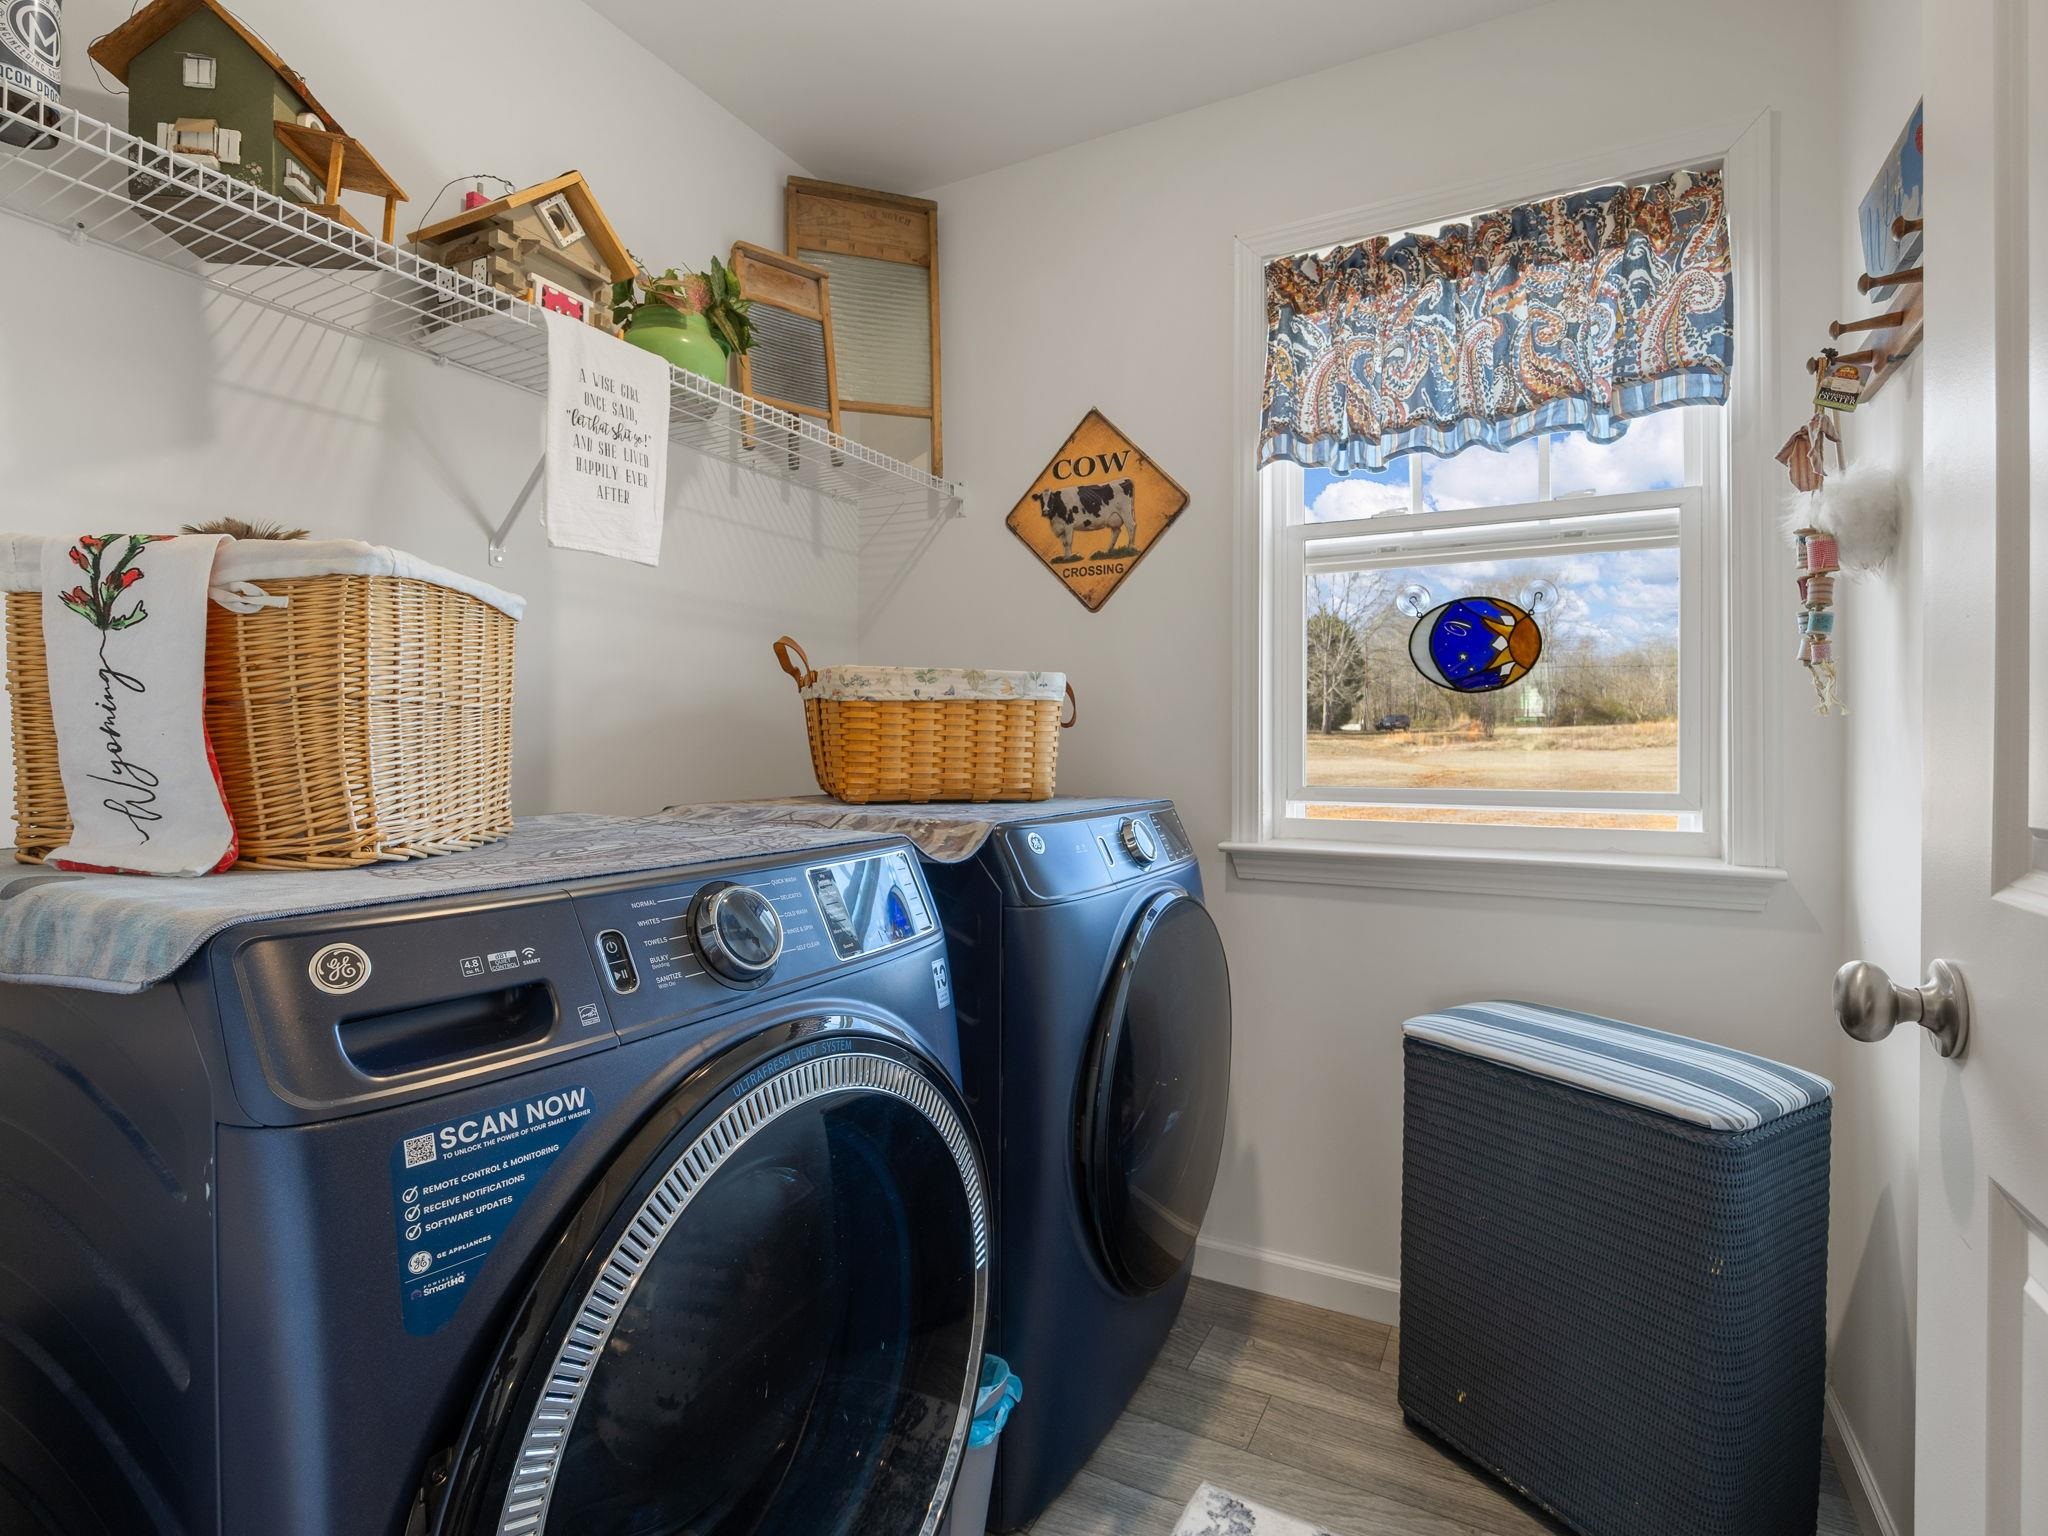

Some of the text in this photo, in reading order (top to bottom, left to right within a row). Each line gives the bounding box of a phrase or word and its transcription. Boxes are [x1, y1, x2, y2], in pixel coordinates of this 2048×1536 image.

[578, 368, 640, 404] A WISE GIRL
[584, 391, 638, 425] ONCE SAID,
[573, 433, 649, 468] AND SHE LIVED
[576, 456, 649, 488] HAPPILY EVER
[1052, 450, 1132, 480] COW
[597, 484, 630, 504] AFTER
[1062, 563, 1124, 579] CROSSING
[631, 900, 657, 909] NORMAL
[637, 917, 660, 927] WHITES
[644, 936, 668, 946] TOWELS
[464, 959, 479, 969] 4.8
[522, 957, 541, 965] SMART
[649, 954, 669, 964] BULKY
[656, 971, 682, 984] SANITIZE
[733, 1040, 852, 1097] ULTRAFRESH VENT SYSTEM
[439, 1087, 586, 1149] SCAN NOW
[443, 1152, 453, 1160] TO
[454, 1143, 482, 1157] UNLOCK
[483, 1138, 496, 1147] THE
[497, 1131, 519, 1143] POWER
[530, 1123, 546, 1133] YOUR
[547, 1116, 567, 1127] SMART
[567, 1108, 591, 1120] WASHER
[423, 1144, 560, 1195] REMOTE CONTROL & MONITORING
[423, 1173, 526, 1215] RECEIVE NOTIFICATIONS
[425, 1195, 513, 1232] SOFTWARE UPDATES
[436, 1251, 447, 1259] GE
[448, 1234, 492, 1255] APPLIANCES
[423, 1275, 466, 1296] SmartHQ
